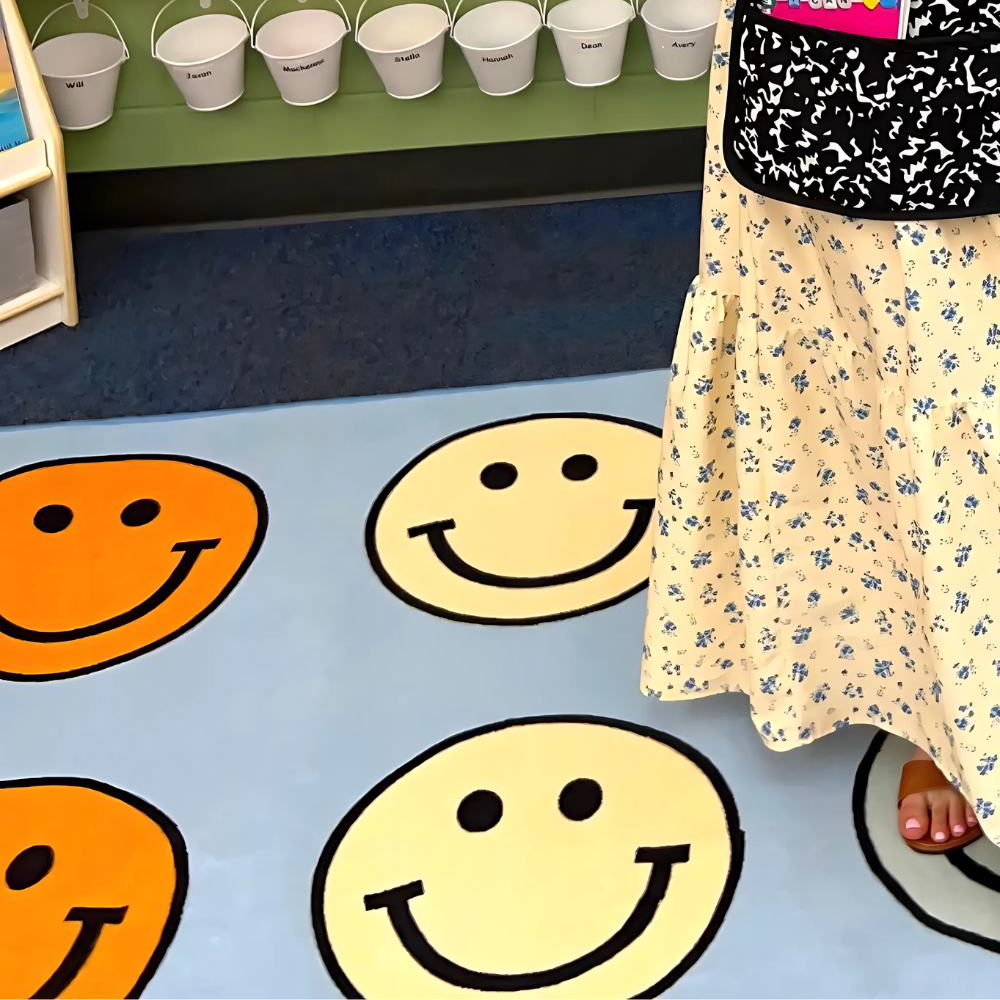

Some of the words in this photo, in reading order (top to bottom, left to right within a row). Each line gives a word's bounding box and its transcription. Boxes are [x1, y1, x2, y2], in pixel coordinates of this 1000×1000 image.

[671, 41, 696, 49] Avery
[482, 53, 513, 63] Hannah
[65, 81, 84, 89] Will
